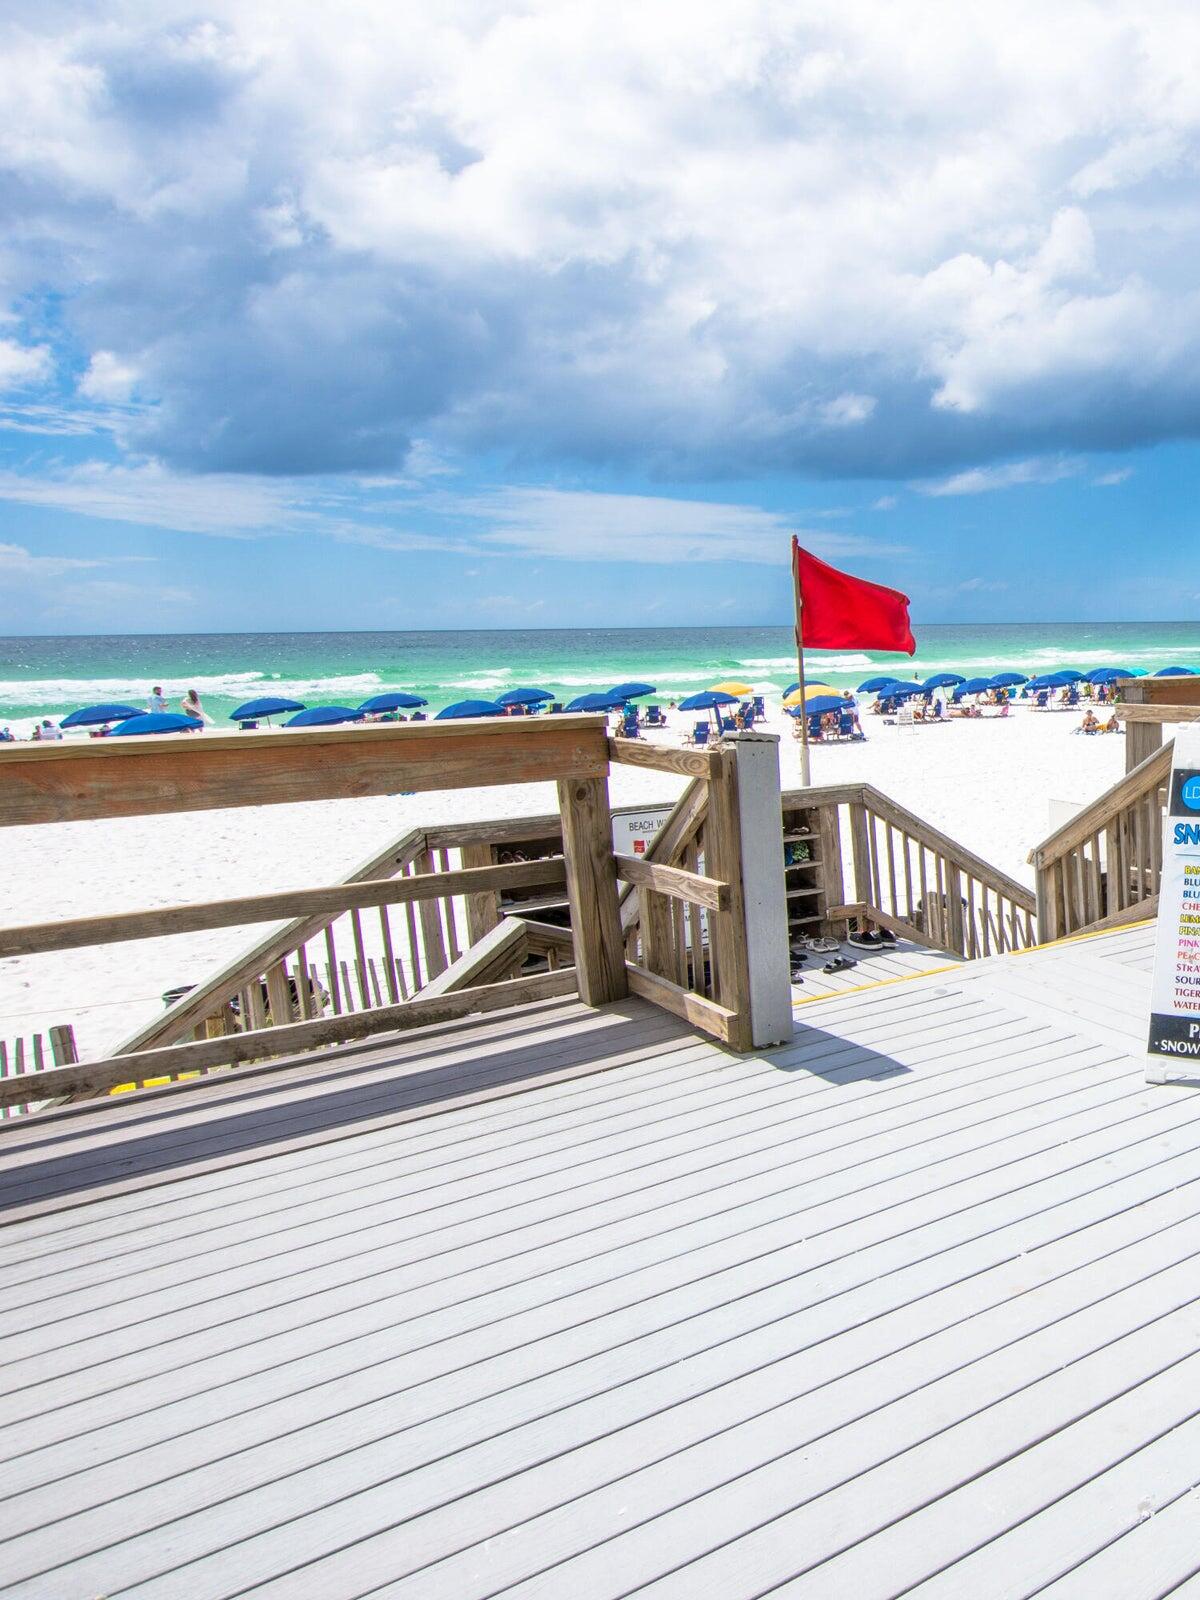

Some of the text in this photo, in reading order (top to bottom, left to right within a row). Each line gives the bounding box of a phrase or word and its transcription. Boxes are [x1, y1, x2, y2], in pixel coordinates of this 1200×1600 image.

[629, 821, 653, 831] BEACH
[1178, 939, 1200, 948] PINK
[1160, 1040, 1200, 1054] SNOW
